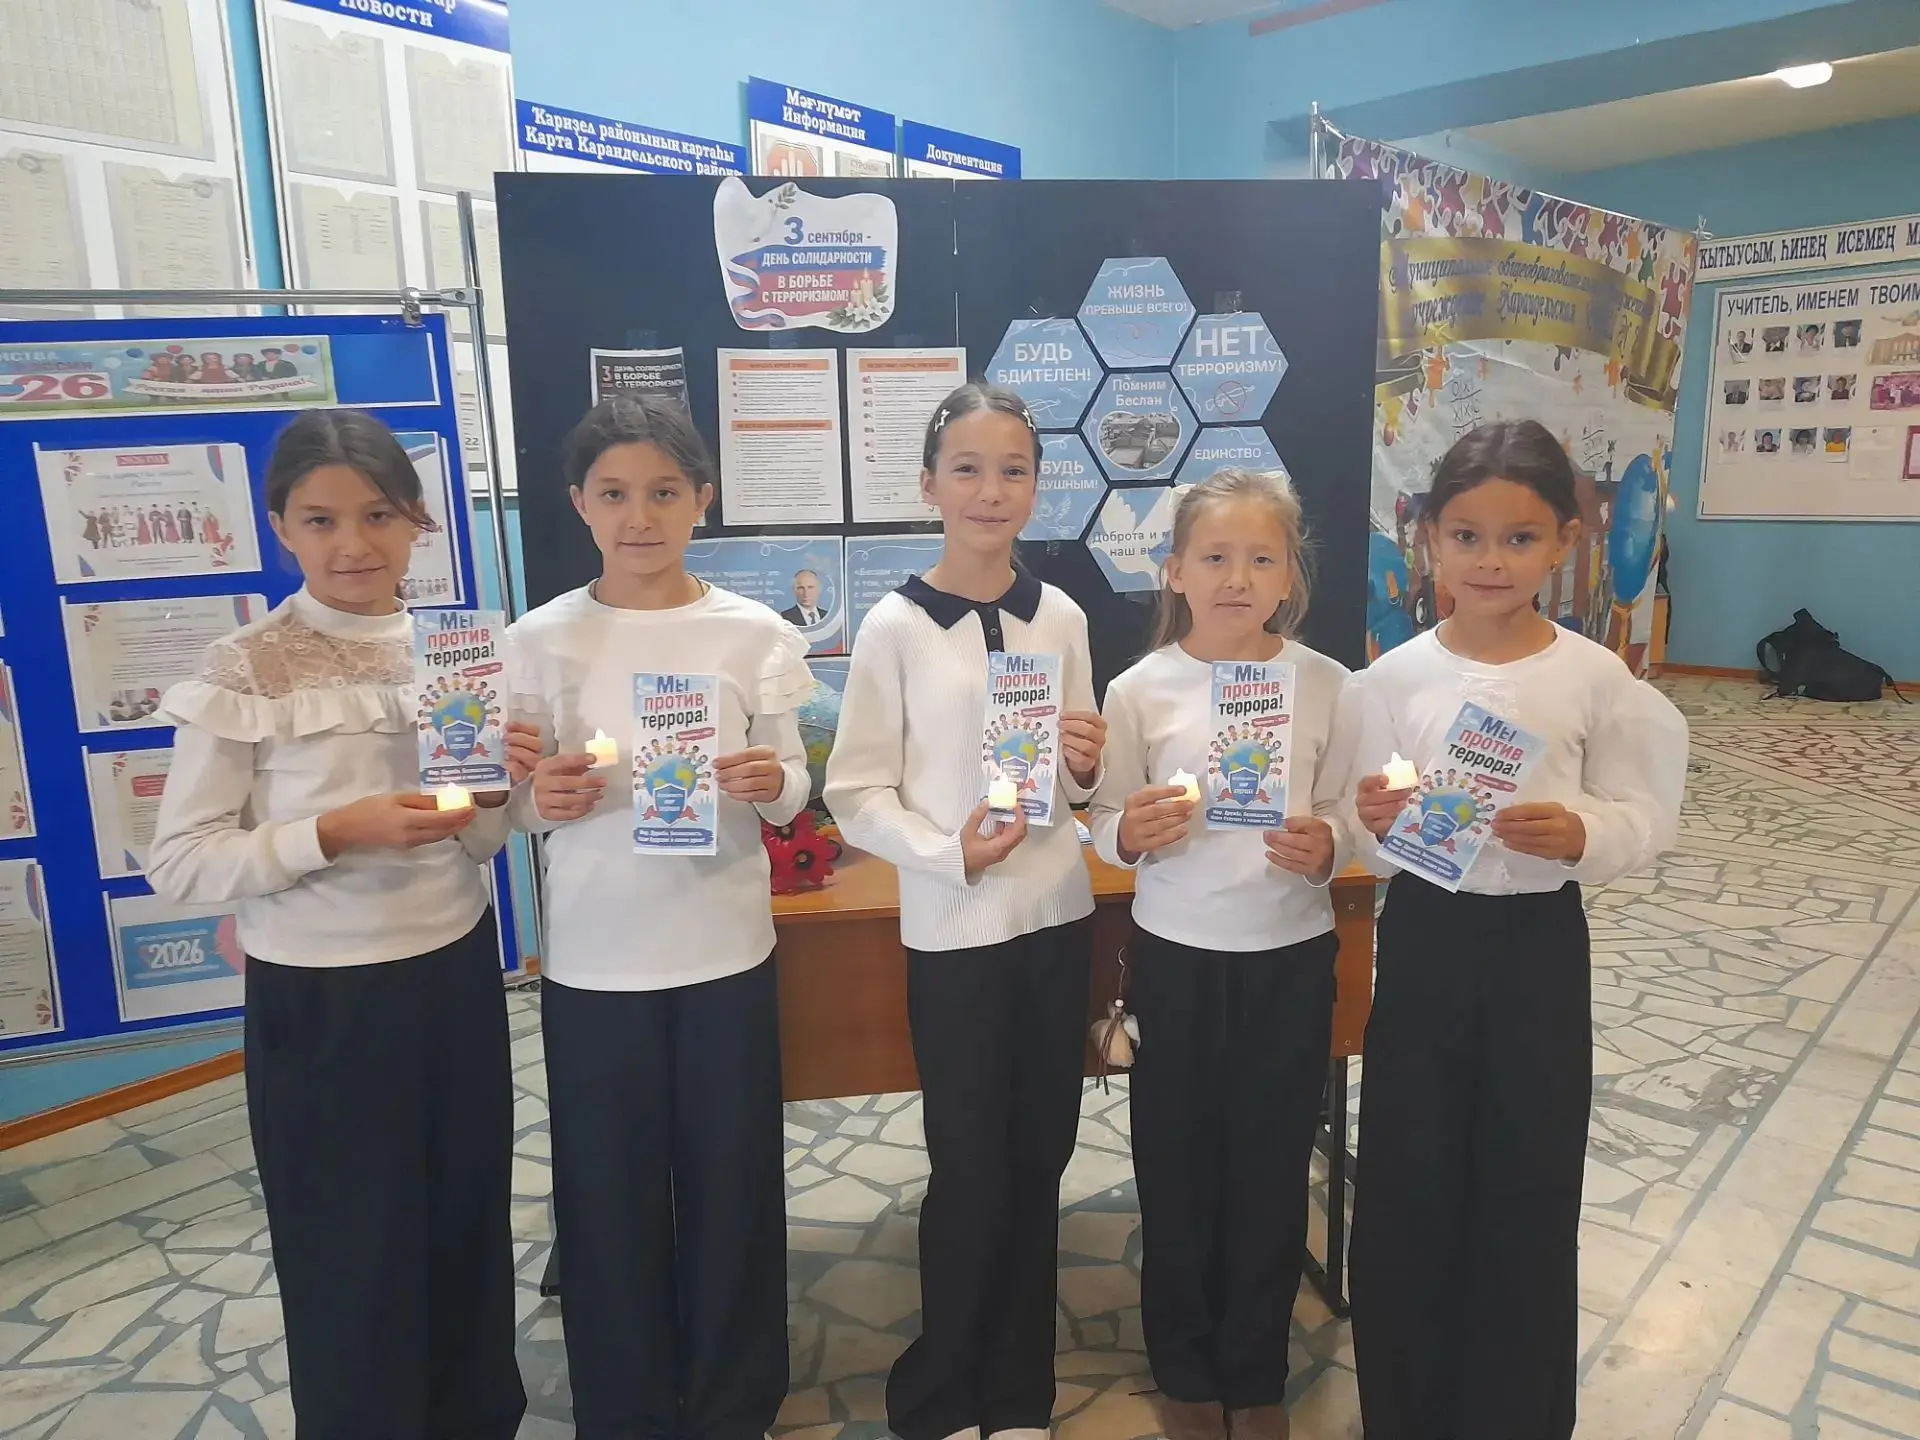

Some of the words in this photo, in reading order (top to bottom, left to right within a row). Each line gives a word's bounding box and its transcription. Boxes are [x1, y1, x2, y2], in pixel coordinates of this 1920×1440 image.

[783, 105, 866, 141] Информация
[524, 125, 573, 151] Карта
[926, 143, 1003, 175] Документация
[784, 217, 804, 245] 3
[808, 229, 863, 247] сентября
[762, 253, 789, 267] ДЕНЬ
[792, 252, 872, 266] СОЛИДАРНОСТИ
[778, 276, 786, 288] В
[789, 274, 833, 288] БОРЬБЕ
[762, 291, 770, 303] С
[772, 290, 849, 303] ТЕРРОРИЗМОМ!
[1108, 284, 1165, 298] ЖИЗНЬ
[1085, 303, 1144, 315] ПРЕВЫШЕ
[1147, 301, 1188, 313] ВСЕГО!
[1727, 295, 1792, 317] УЧИТЕЛЬ,
[1796, 288, 1859, 311] ИМЕНЕМ
[1195, 326, 1264, 357] НЕТ
[1015, 342, 1073, 363] БУДЬ
[614, 372, 621, 380] В
[623, 372, 662, 380] БОРЬБЕ
[997, 367, 1091, 384] БДИТЕЛЕН!
[1177, 359, 1283, 377] ТЕРРОРИЗМУ!
[1112, 379, 1167, 392] Помним
[1116, 394, 1162, 406] Беслан
[1195, 447, 1262, 460] ЕДИНСТВО
[1040, 460, 1084, 476] БУДЬ
[1039, 479, 1098, 490] ДУШНЫМ!
[1093, 531, 1144, 544] Доброта
[1110, 548, 1135, 556] наш
[440, 613, 473, 630] Мы
[428, 628, 490, 651] против
[424, 641, 495, 668] террора!
[1006, 656, 1034, 673] Мы
[1235, 664, 1266, 682] Мы
[657, 675, 688, 694] Мы
[996, 673, 1047, 691] против
[1222, 681, 1280, 701] против
[644, 693, 704, 714] против
[992, 685, 1051, 707] террора!
[1219, 694, 1283, 717] террора!
[641, 706, 708, 731] террора!
[1479, 715, 1518, 742] Мы
[1458, 729, 1524, 761] против
[1448, 743, 1522, 777] террора!
[149, 939, 204, 969] 2026
